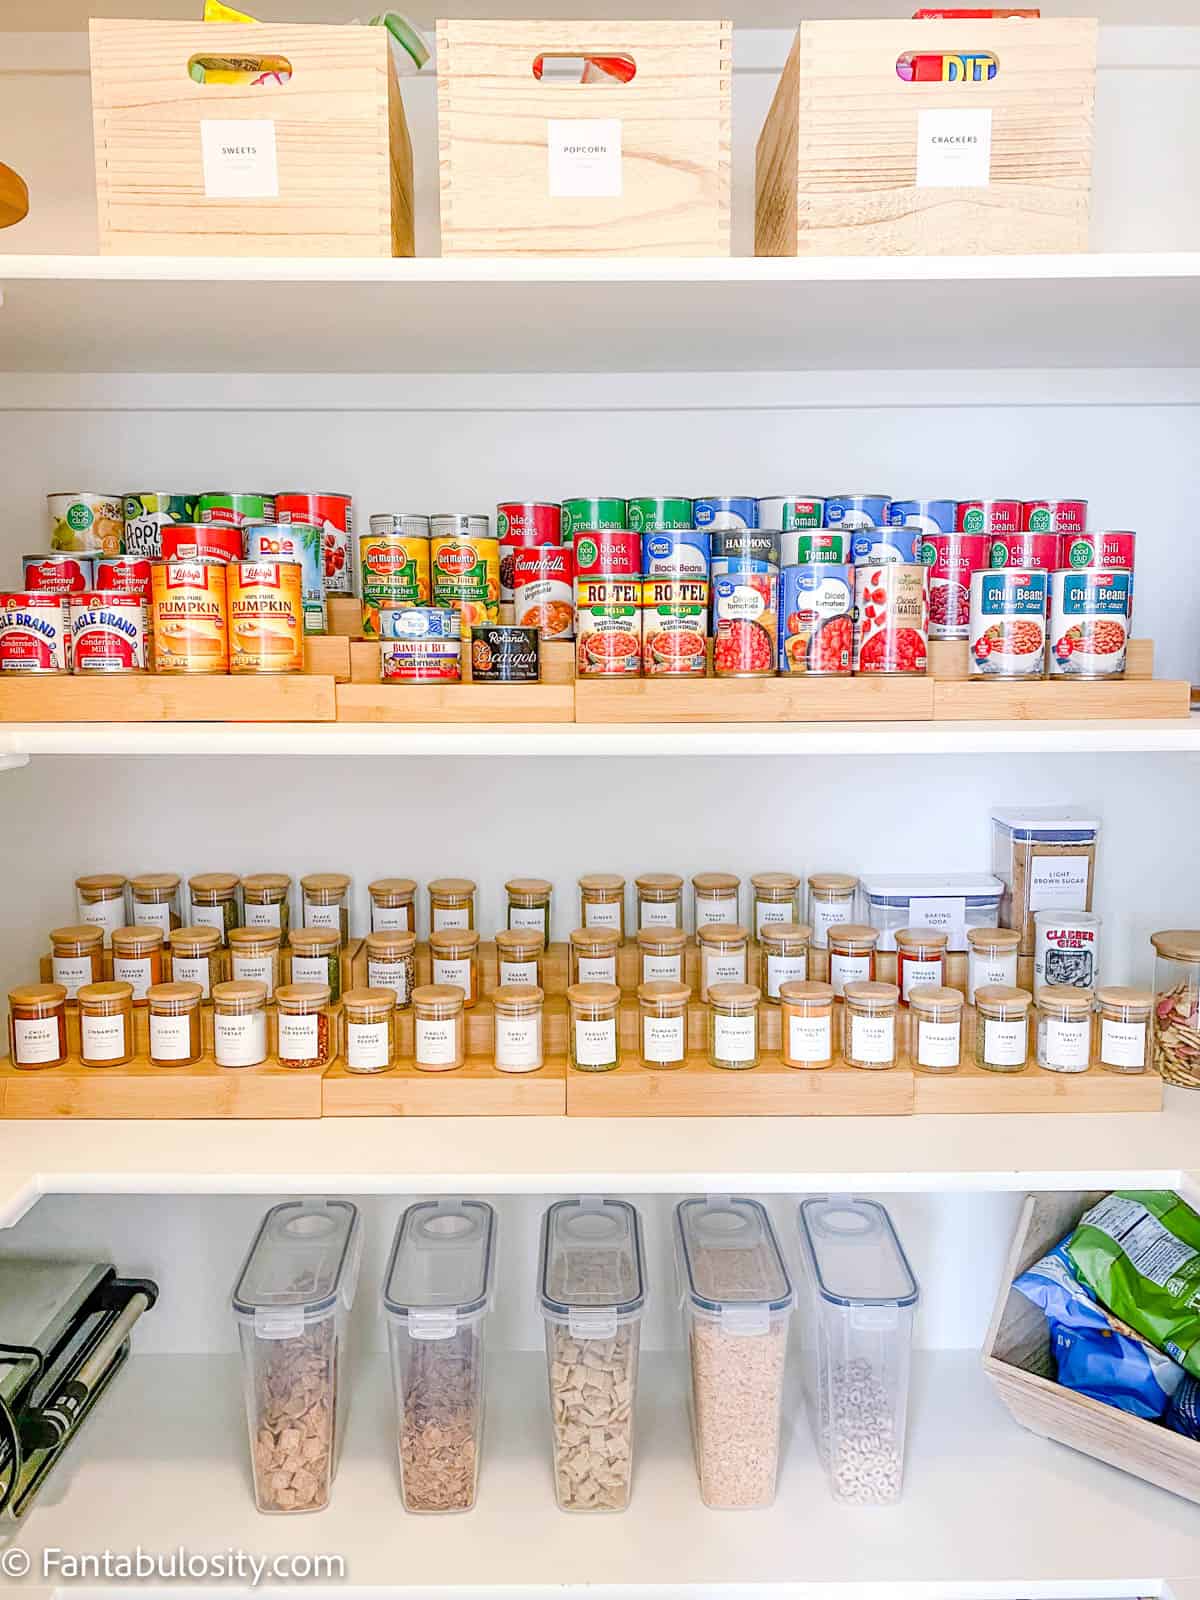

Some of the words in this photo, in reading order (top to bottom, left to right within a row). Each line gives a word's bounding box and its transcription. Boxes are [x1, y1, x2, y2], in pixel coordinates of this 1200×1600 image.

[931, 136, 977, 144] CRACKERS
[221, 146, 257, 155] SWEETS
[563, 146, 607, 154] POPCORN
[510, 515, 535, 526] black
[990, 511, 1010, 521] chili
[1056, 511, 1076, 521] chili
[71, 517, 89, 525] club
[573, 521, 597, 530] green
[599, 519, 622, 529] beans
[645, 520, 671, 530] green
[790, 518, 818, 526] Tomato
[968, 522, 983, 530] club
[990, 522, 1015, 531] beans
[1033, 522, 1048, 530] club
[1055, 522, 1081, 531] beans
[510, 526, 538, 536] beans
[260, 537, 294, 551] Dole
[725, 538, 772, 549] HARMONS
[601, 544, 626, 554] black
[940, 545, 961, 555] chili
[1011, 545, 1033, 555] chili
[368, 554, 379, 563] Del
[380, 554, 404, 563] Monte
[439, 554, 450, 563] Del
[451, 554, 475, 563] Monte
[600, 555, 628, 565] beans
[805, 551, 837, 560] Tomato
[1099, 555, 1126, 564] beans
[940, 557, 970, 566] beans
[1011, 556, 1041, 565] beans
[655, 564, 675, 572] Black
[679, 563, 702, 572] Beans
[174, 567, 201, 580] Libby's
[247, 567, 272, 579] Libby's
[38, 577, 75, 585] Sweetened
[112, 577, 148, 585] Sweetened
[383, 586, 414, 595] Peaches
[454, 586, 483, 595] Peaches
[989, 589, 1013, 600] Chili
[1017, 589, 1043, 600] Beans
[1070, 589, 1095, 600] Chili
[1100, 589, 1126, 600] Beans
[824, 592, 845, 600] Diced
[158, 602, 220, 613] PUMPKIN
[232, 601, 293, 612] PUMPKIN
[16, 613, 56, 638] BRAND
[99, 612, 137, 637] BRAND
[489, 632, 524, 645] Roland
[393, 643, 429, 652] BUMBLE
[432, 643, 446, 652] BEE
[478, 646, 537, 666] Escargots
[399, 659, 441, 668] Crabmeat
[1046, 930, 1095, 942] CLABBER
[1057, 940, 1083, 948] GIRL
